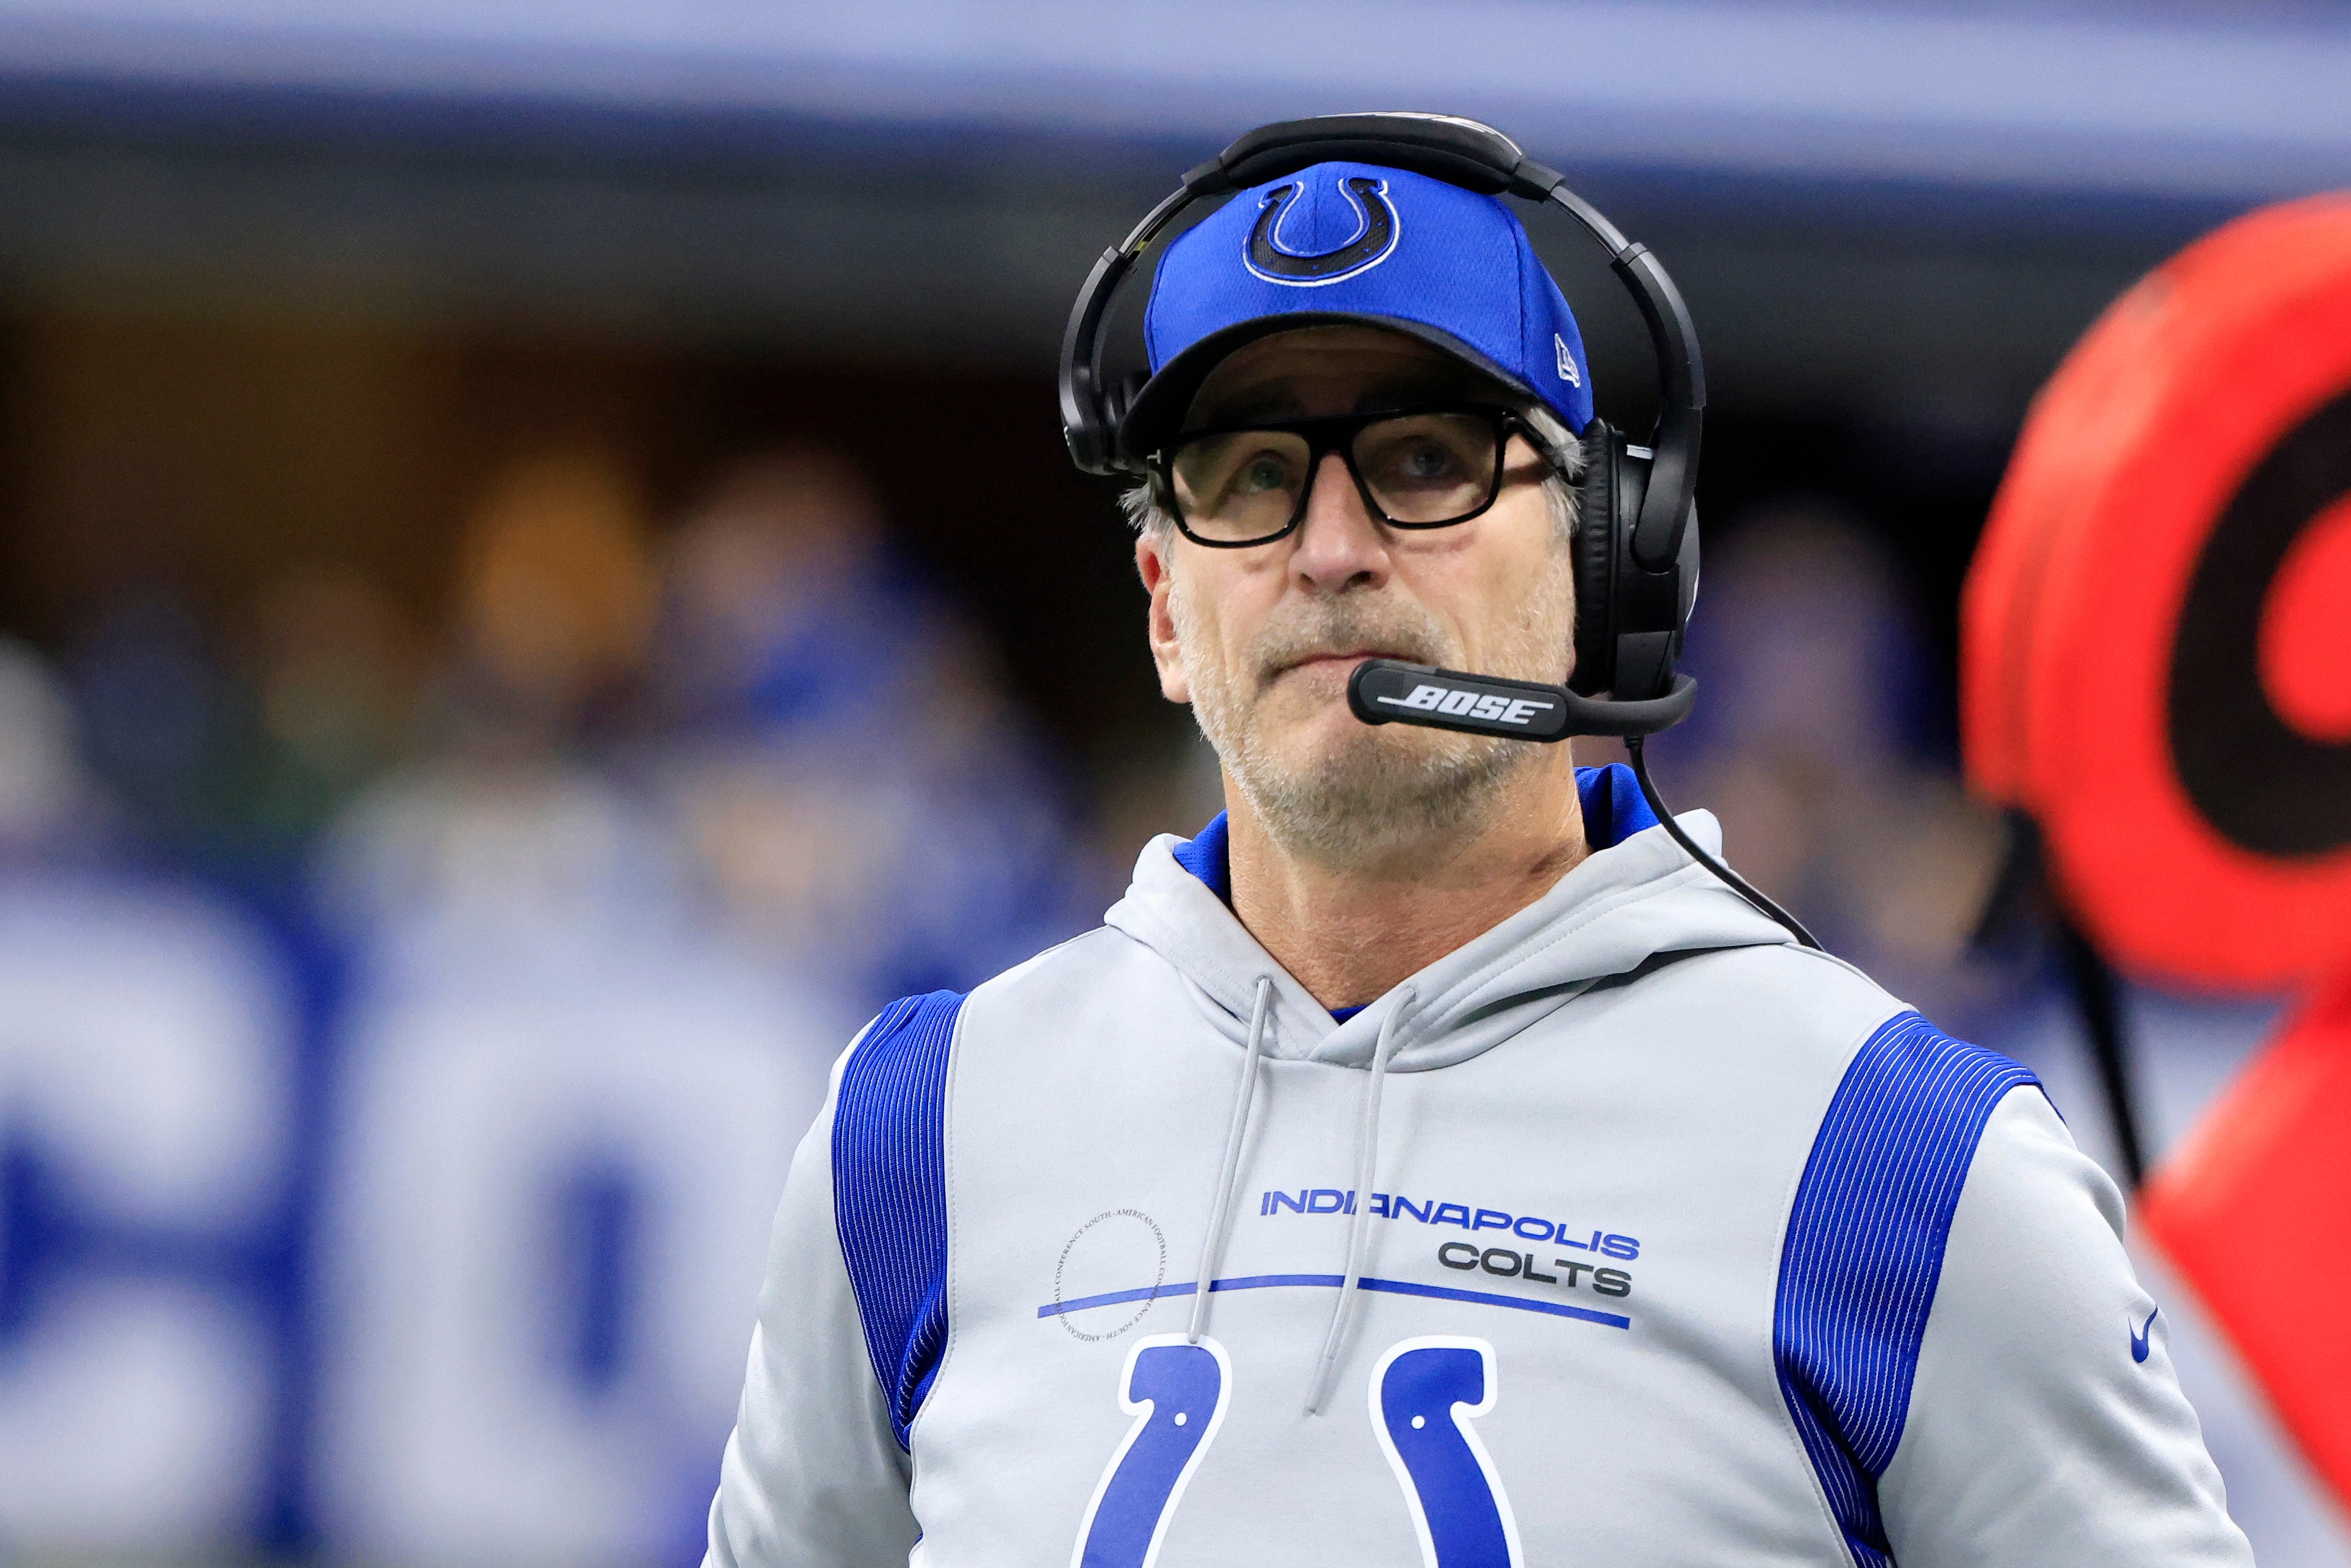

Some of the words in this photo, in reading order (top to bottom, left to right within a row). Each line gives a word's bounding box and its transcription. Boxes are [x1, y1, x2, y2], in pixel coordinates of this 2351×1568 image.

[1377, 685, 1553, 724] BOSE
[1084, 1211, 1111, 1230] SOUTH
[1115, 1209, 1154, 1226] AMERICAN
[1260, 1189, 1640, 1261] INDIANAPOLIS
[1055, 1228, 1084, 1284] CONFERENCE
[1151, 1224, 1167, 1265] FOOTBALL
[1438, 1242, 1632, 1297] COLTS
[1134, 1267, 1165, 1323] CONRENCE
[1066, 1324, 1101, 1342] AMERICAN
[1107, 1321, 1133, 1340] SOUTH
